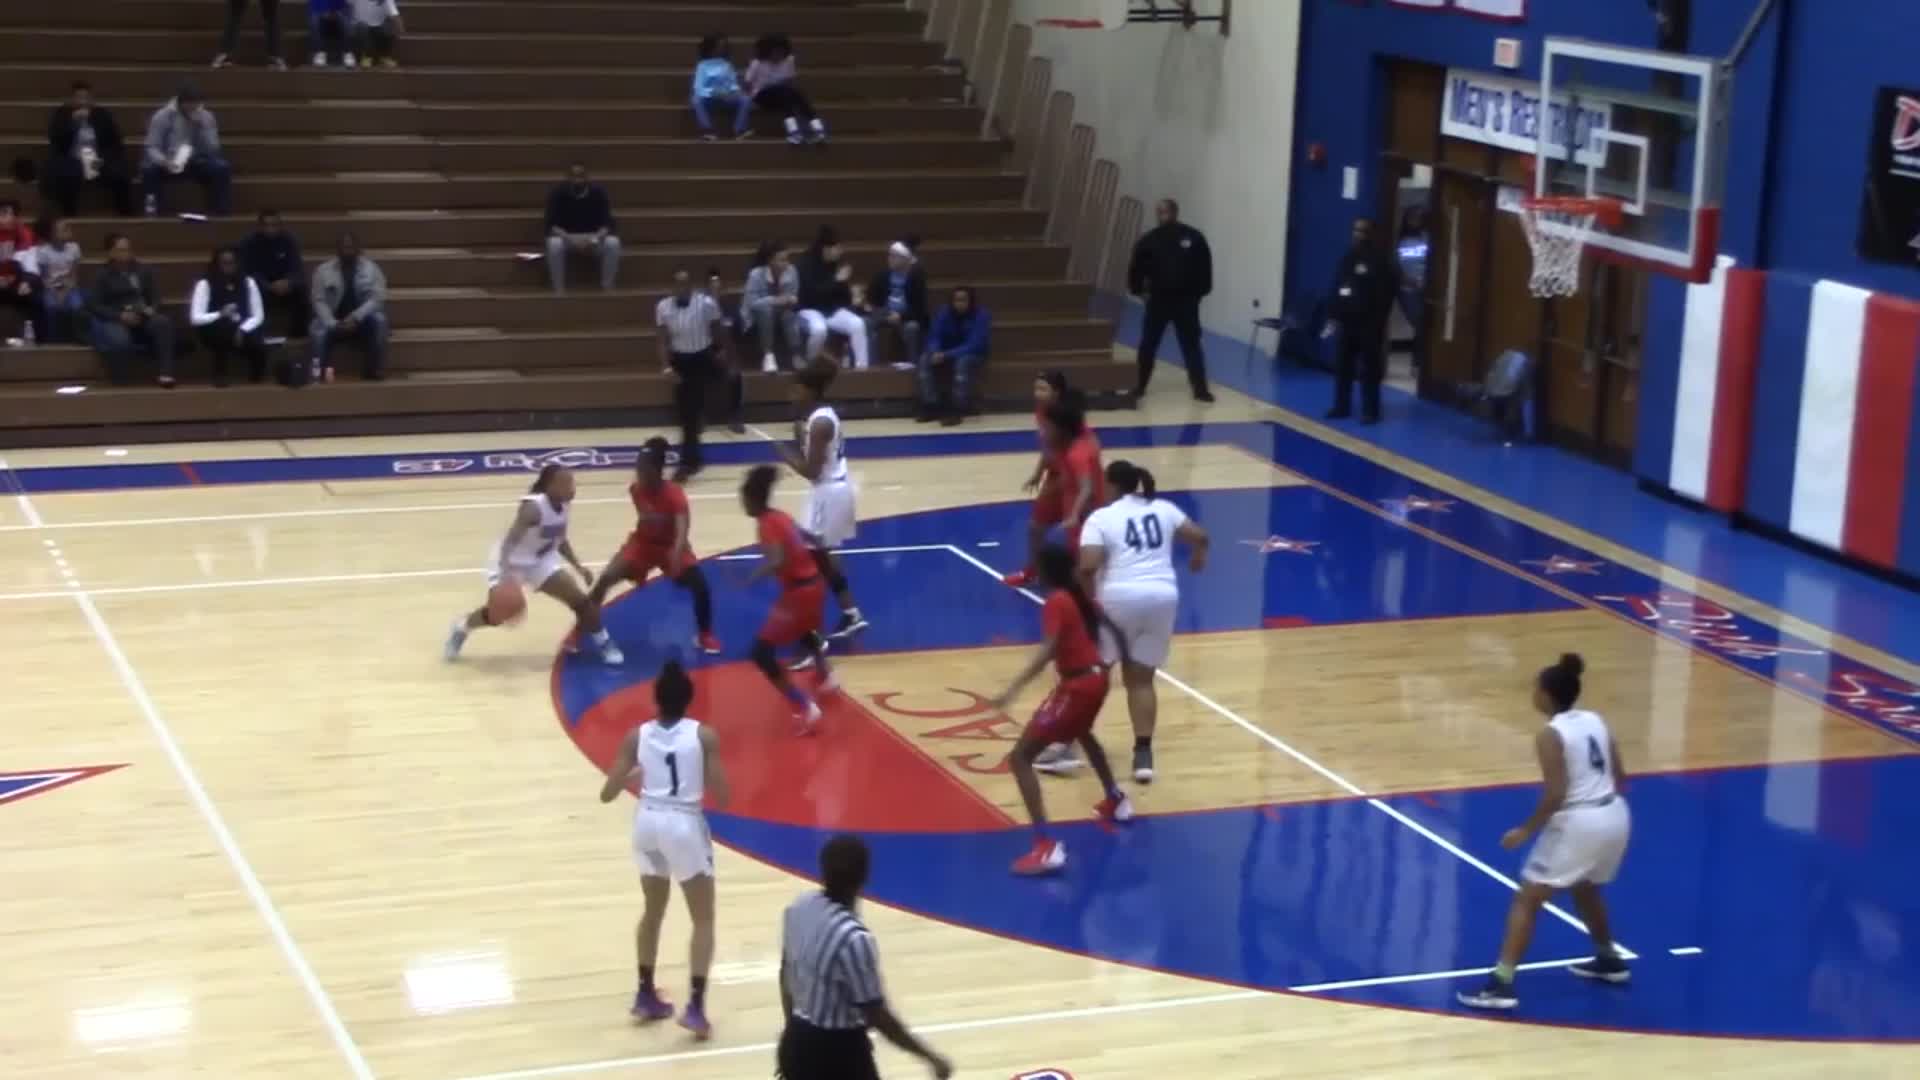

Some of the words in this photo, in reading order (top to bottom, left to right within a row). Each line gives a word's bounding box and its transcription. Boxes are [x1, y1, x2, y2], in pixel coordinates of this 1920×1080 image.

[1125, 513, 1163, 552] 40
[664, 751, 679, 797] 1
[1588, 734, 1606, 776] 4
